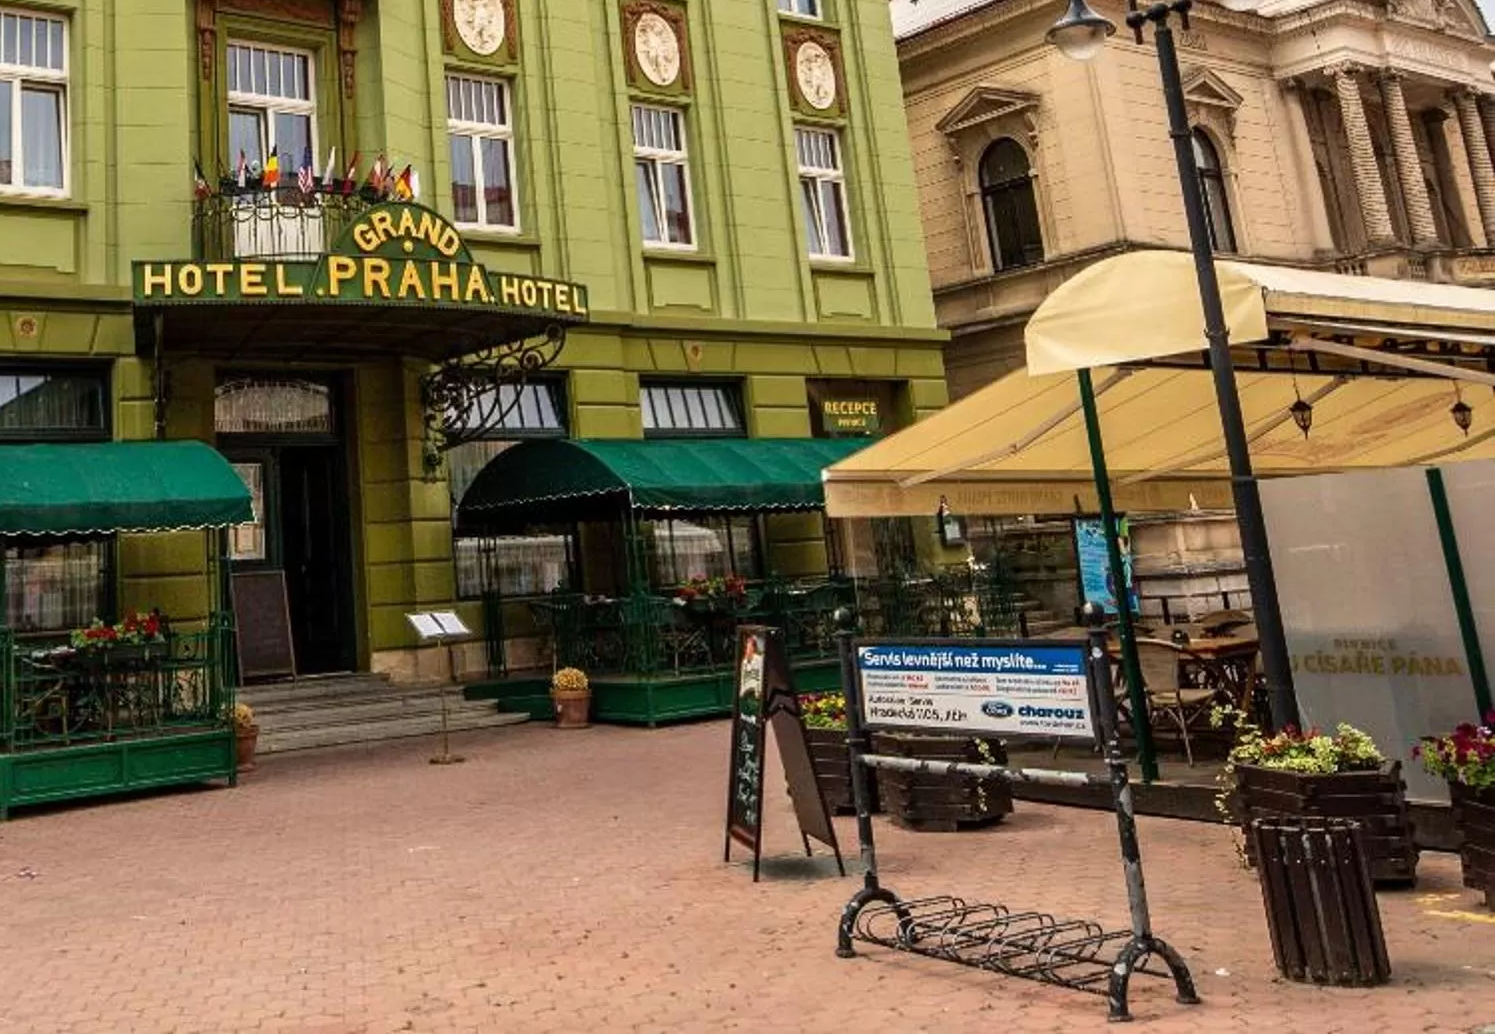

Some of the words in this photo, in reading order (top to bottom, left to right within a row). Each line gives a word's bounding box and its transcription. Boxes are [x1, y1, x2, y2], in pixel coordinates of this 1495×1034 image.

[353, 208, 460, 257] GRAND
[143, 263, 304, 297] HOTEL
[327, 255, 488, 304] PRAHA
[501, 275, 588, 314] HOTEL
[824, 401, 877, 415] RECEPCE
[864, 652, 901, 666] Servis
[902, 651, 953, 669] levnější
[954, 652, 979, 668] než
[981, 652, 1047, 671] myslíte...
[1018, 704, 1085, 719] charouz
